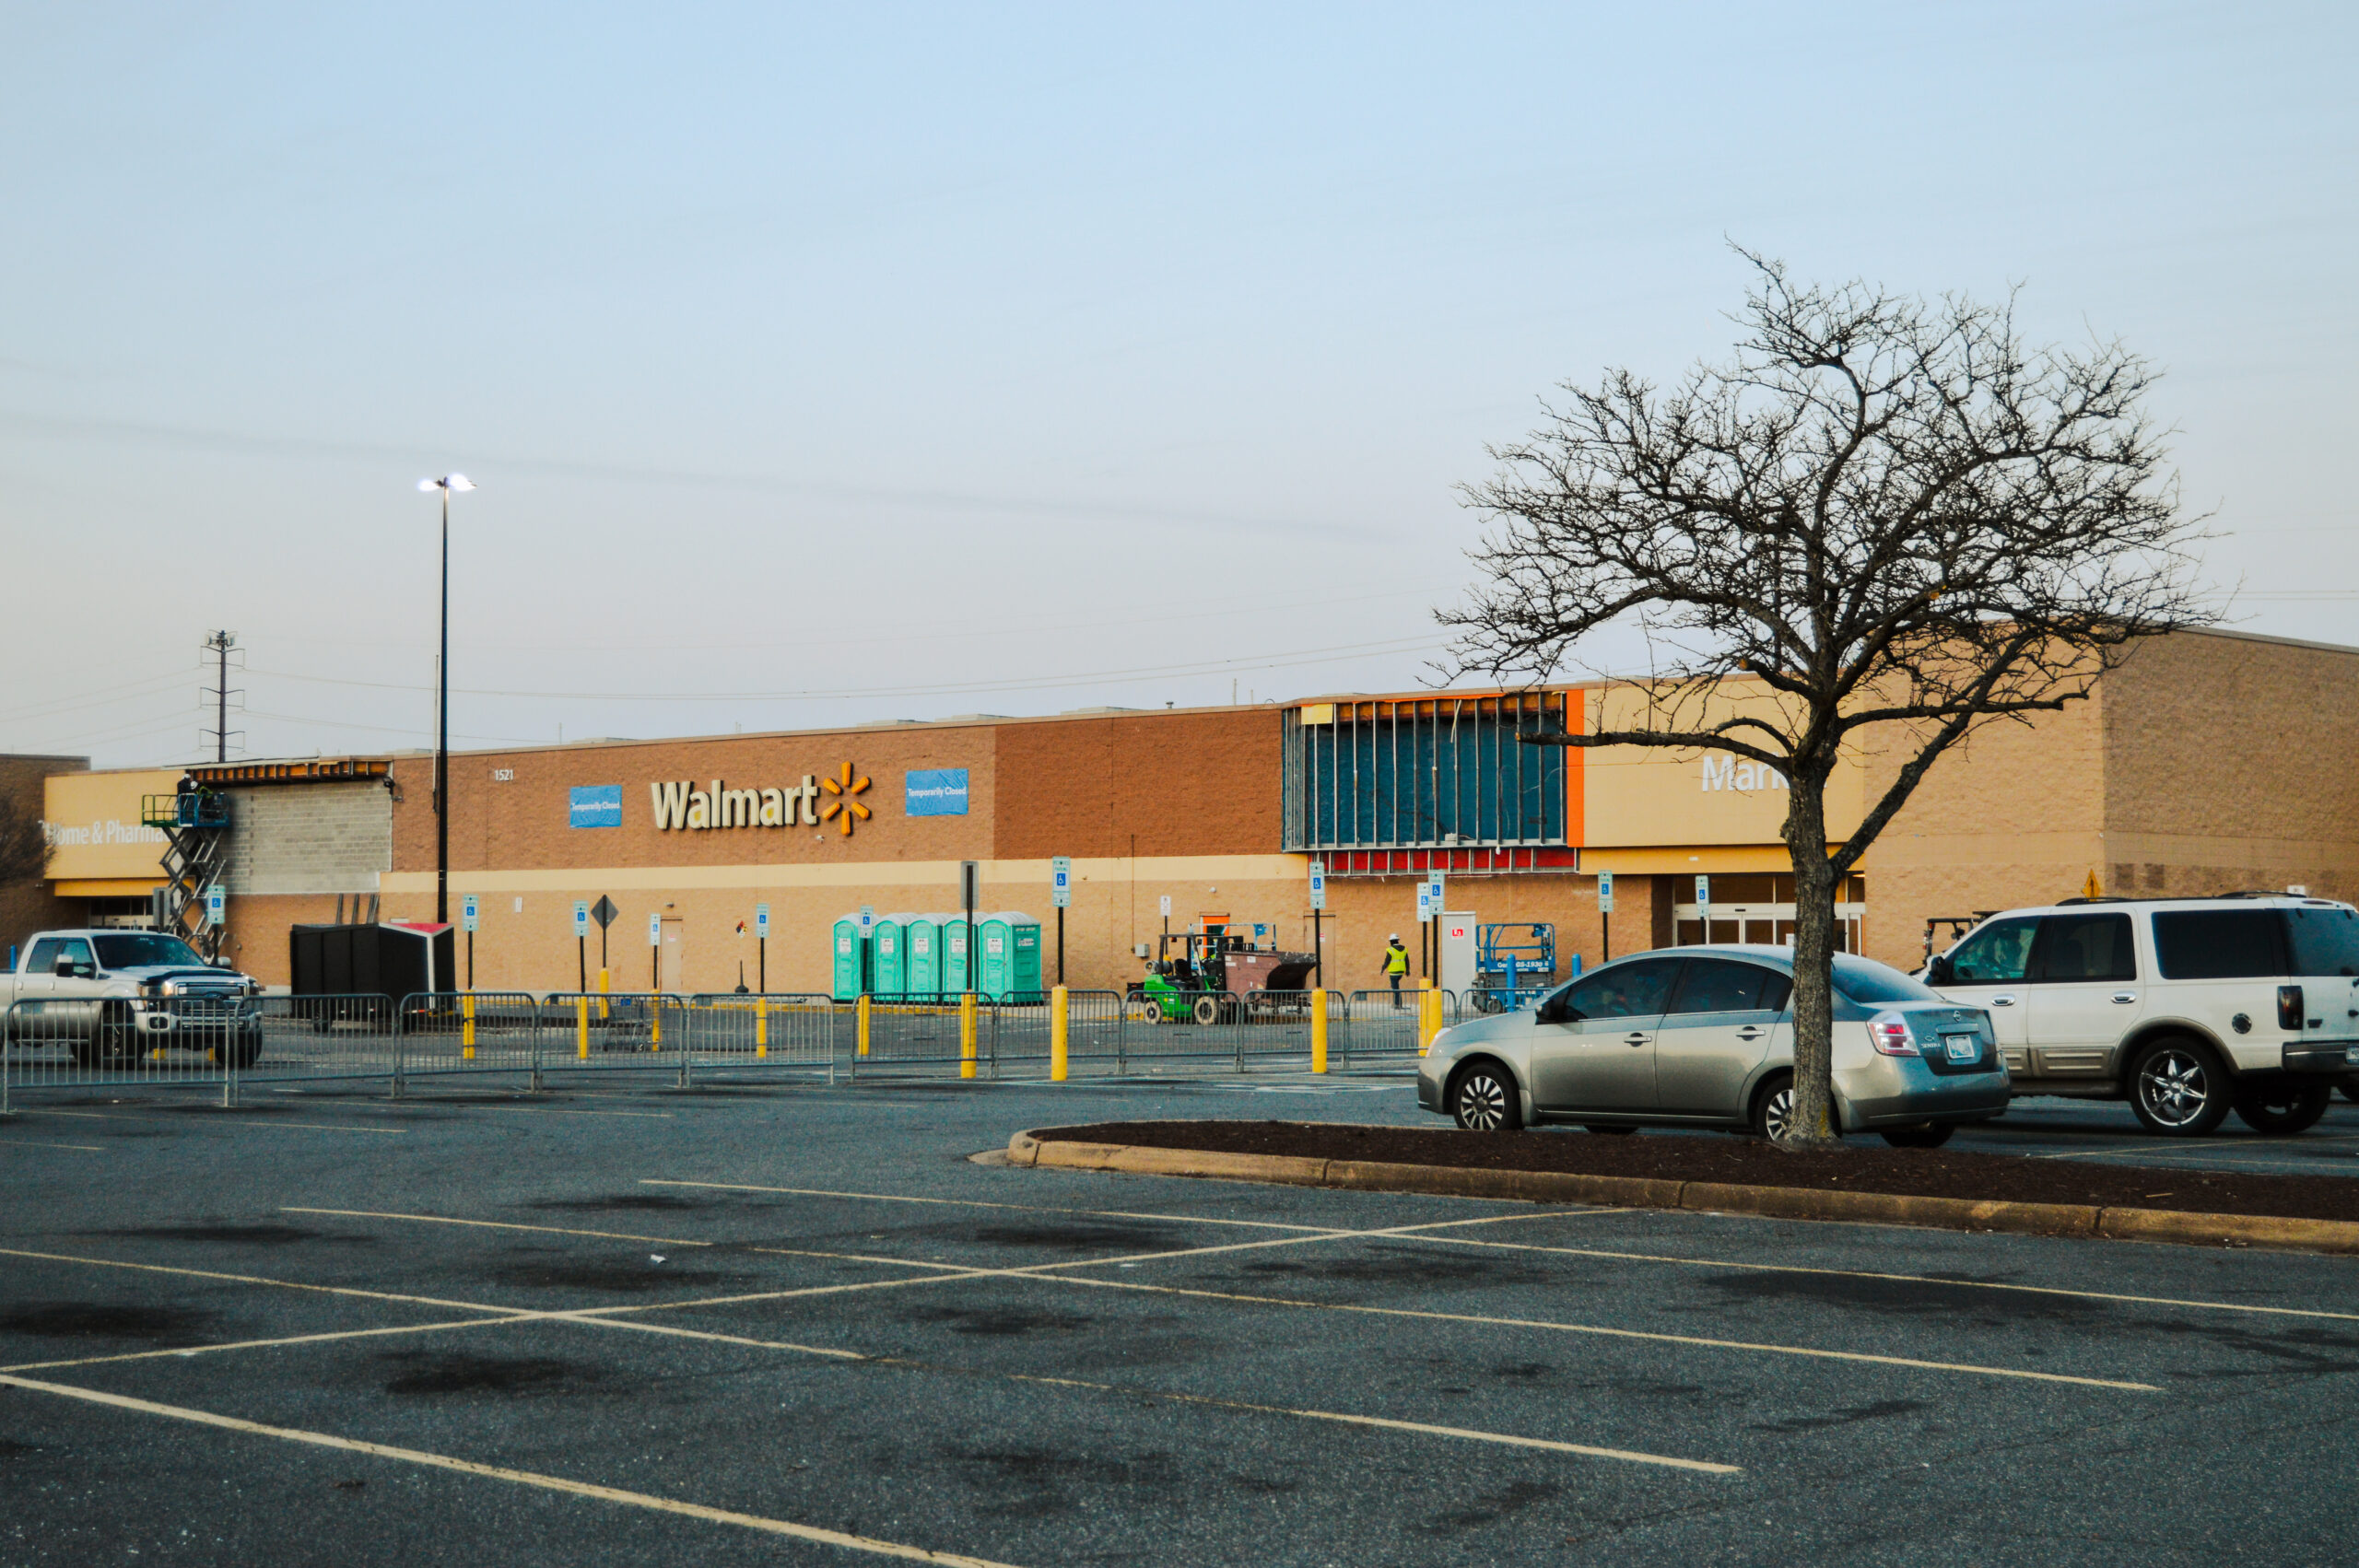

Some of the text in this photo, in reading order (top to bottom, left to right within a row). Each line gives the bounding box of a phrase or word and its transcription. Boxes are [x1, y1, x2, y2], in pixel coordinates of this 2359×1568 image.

[494, 769, 514, 781] 1521
[907, 785, 967, 799] Temporarily Closed
[571, 802, 620, 812] Temporarily Closed
[651, 775, 818, 829] Walmart
[92, 820, 104, 845] &
